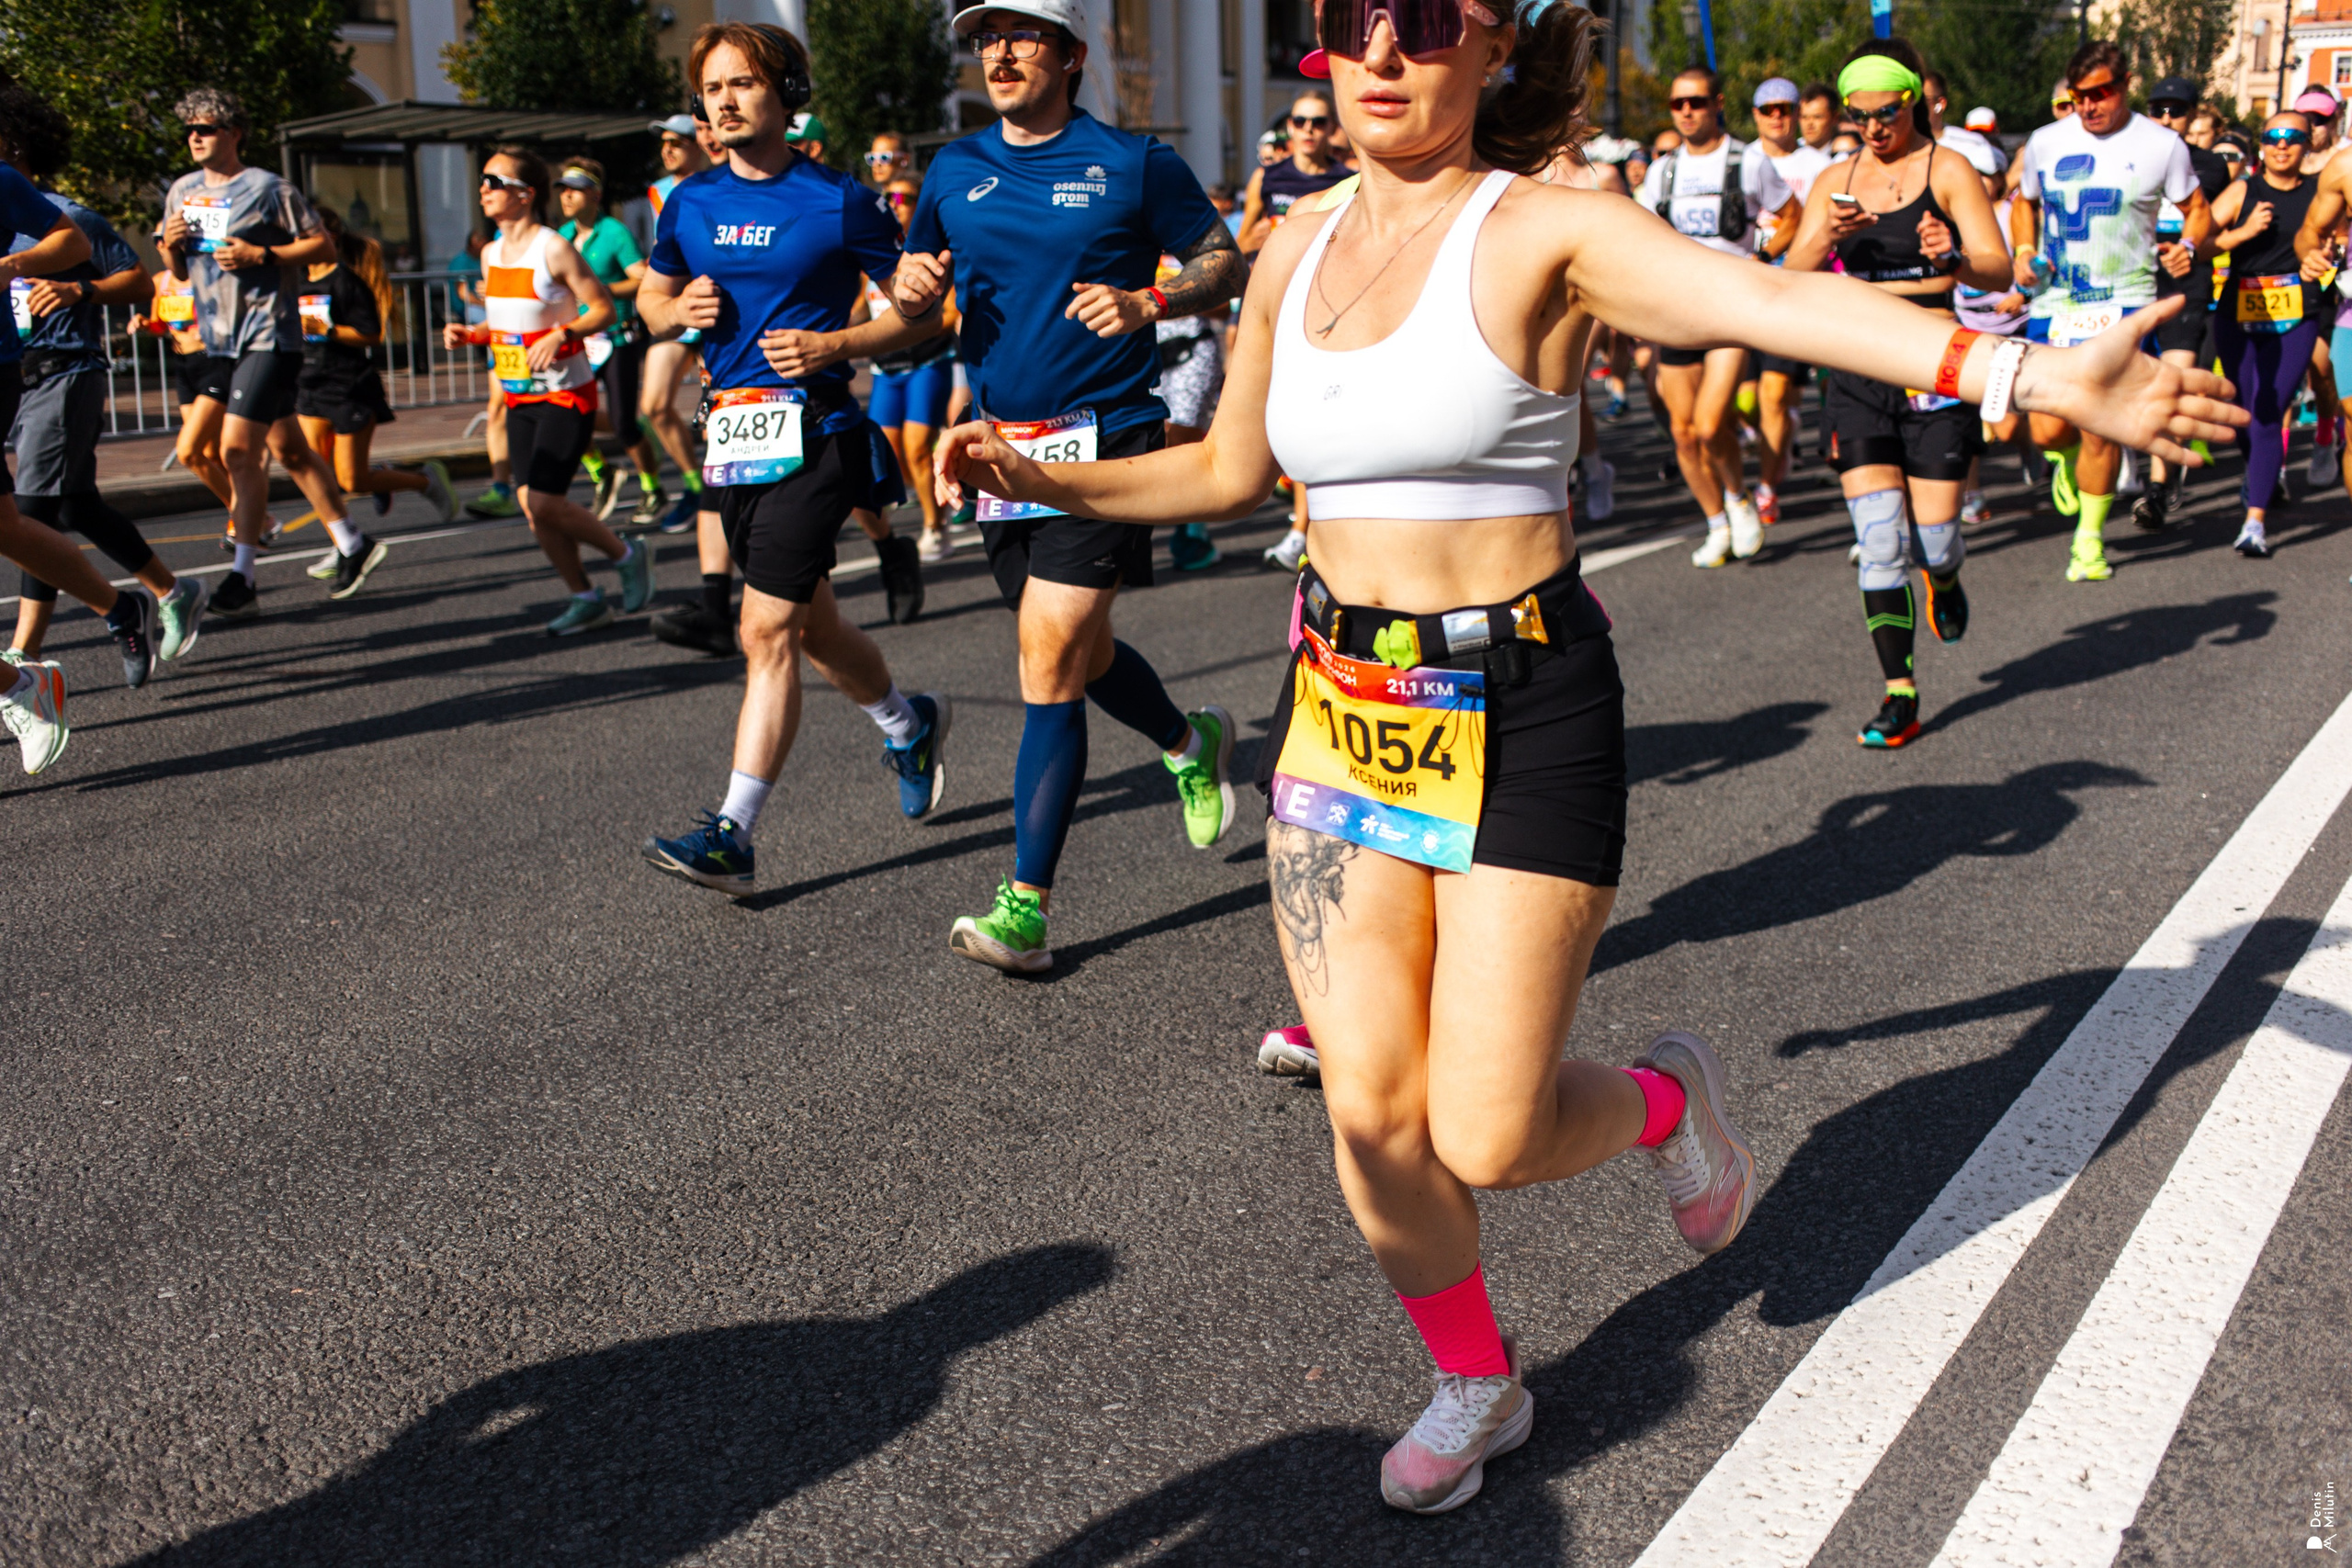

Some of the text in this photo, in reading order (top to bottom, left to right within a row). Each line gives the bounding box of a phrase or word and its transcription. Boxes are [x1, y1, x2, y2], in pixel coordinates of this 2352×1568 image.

[1052, 192, 1089, 206] grom
[2245, 292, 2290, 311] 5321
[1940, 343, 1966, 385] 1054
[718, 410, 787, 446] 3487
[712, 466, 725, 483] E
[989, 500, 1003, 516] E
[1385, 678, 1419, 697] 21,1
[1319, 698, 1456, 782] 1054
[1348, 764, 1417, 797] КСЕНИЯ
[1285, 783, 1316, 819] E
